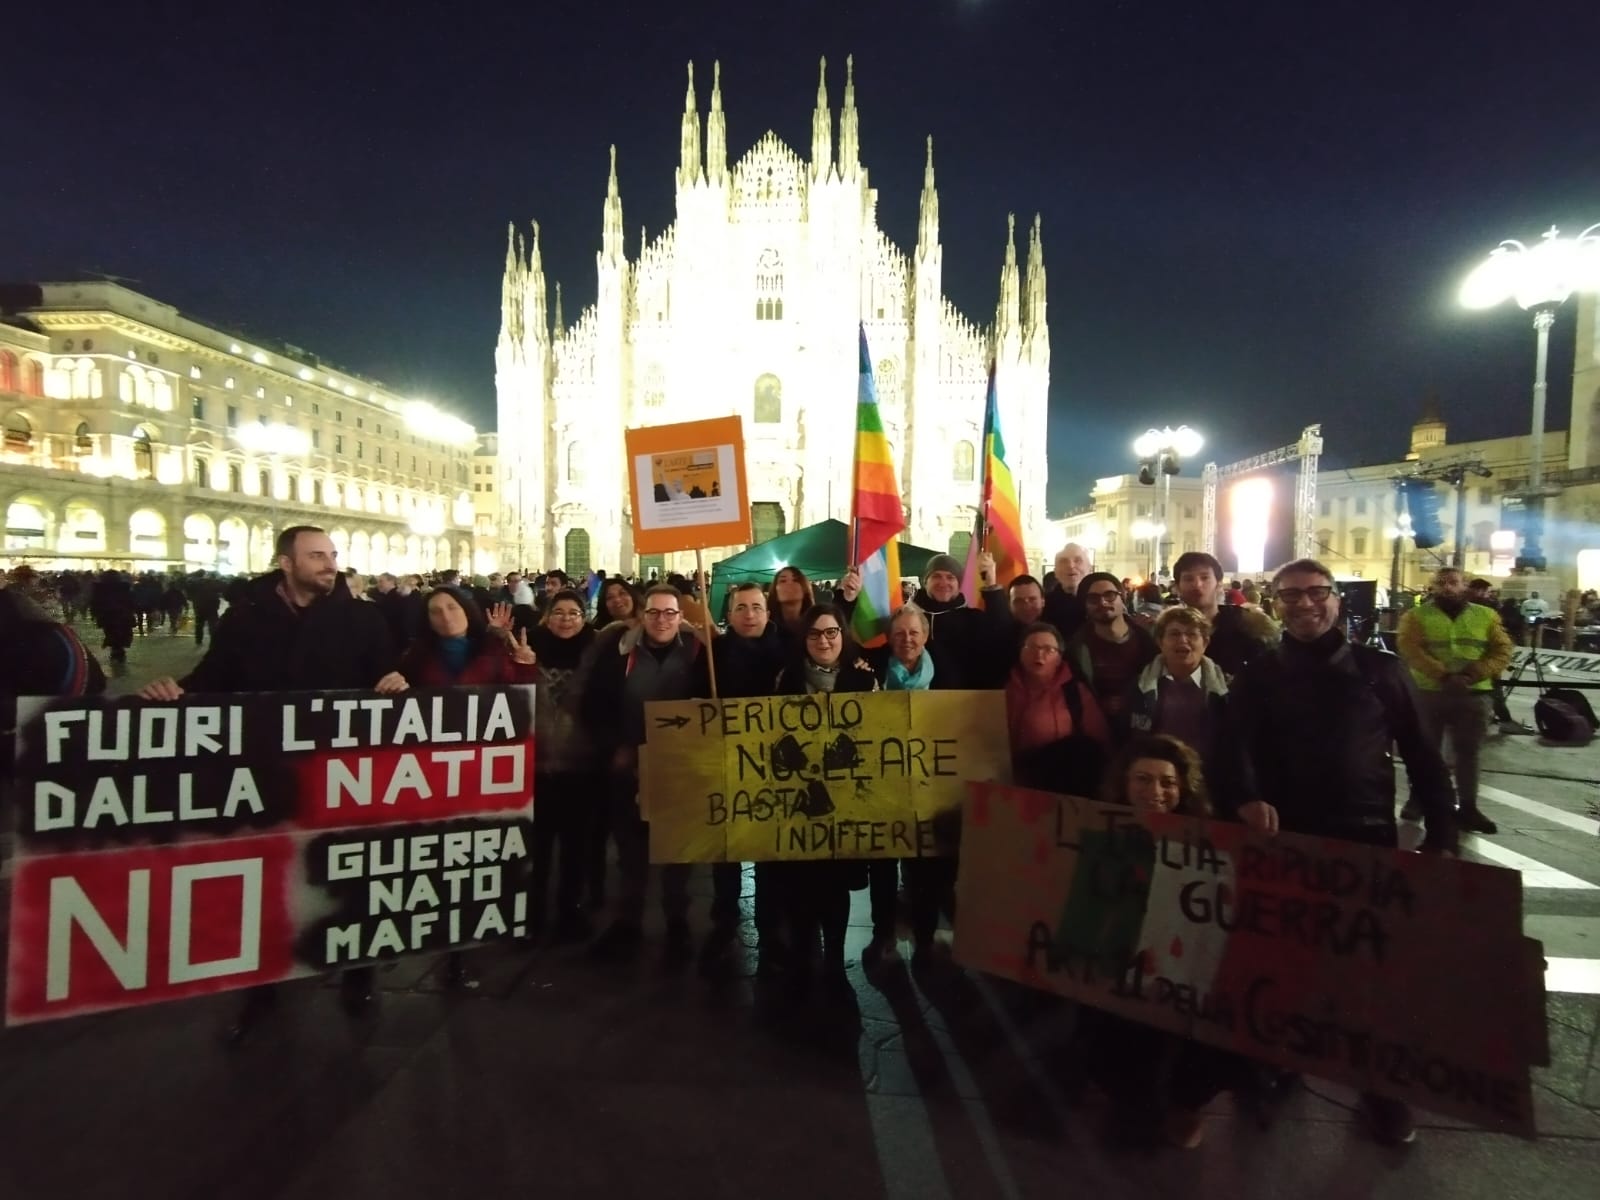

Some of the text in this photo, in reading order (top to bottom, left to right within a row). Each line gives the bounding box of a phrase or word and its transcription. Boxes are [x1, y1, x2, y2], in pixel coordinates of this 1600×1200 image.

[45, 693, 516, 763] FUORI L'ITALIA
[698, 699, 863, 737] PERICOLO
[736, 736, 958, 782] NUCLEARE
[34, 745, 525, 831] DALLA NATO
[706, 787, 816, 826] BASTA
[328, 826, 526, 880] GUERRA
[776, 818, 934, 854] INDIFFERE
[369, 867, 500, 916] NATO
[46, 858, 263, 1002] NO
[326, 892, 527, 964] MAFIA!
[1180, 880, 1390, 966] GUERRA
